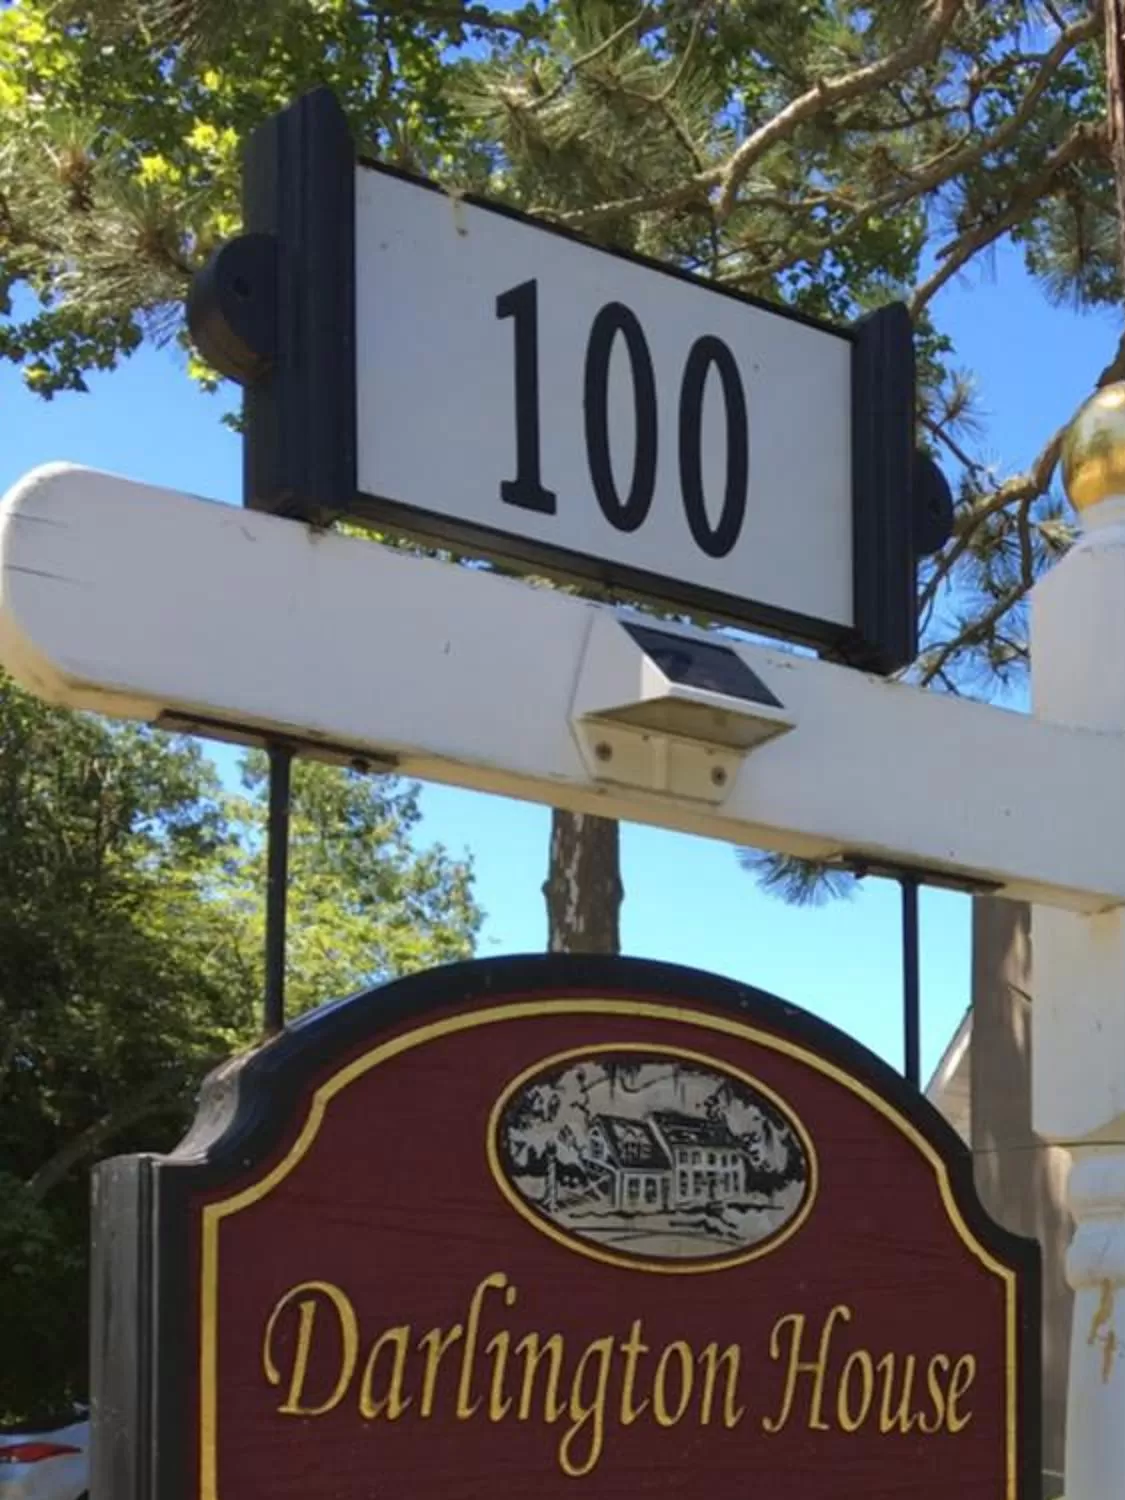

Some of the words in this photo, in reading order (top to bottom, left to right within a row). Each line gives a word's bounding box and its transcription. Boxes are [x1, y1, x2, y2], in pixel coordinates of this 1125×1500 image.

[495, 278, 749, 559] 100
[263, 1272, 746, 1477] Darlington
[761, 1304, 976, 1433] House
